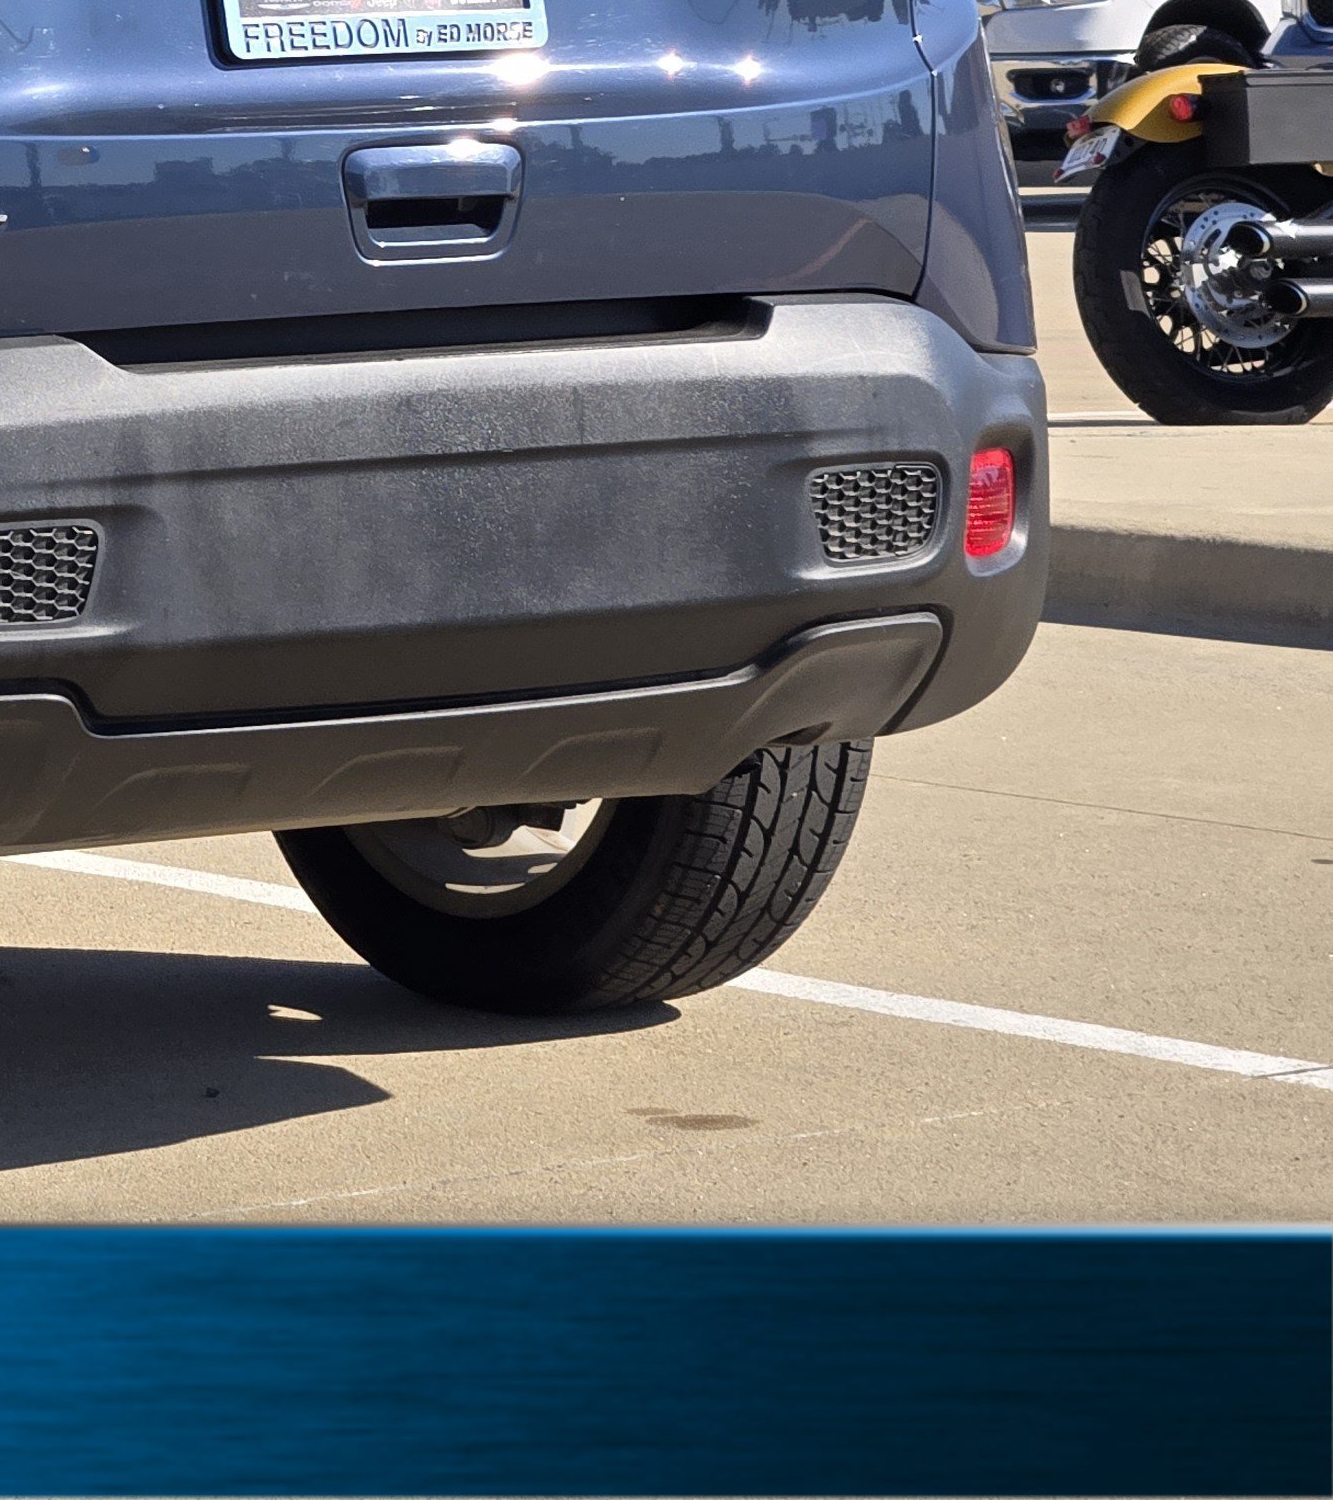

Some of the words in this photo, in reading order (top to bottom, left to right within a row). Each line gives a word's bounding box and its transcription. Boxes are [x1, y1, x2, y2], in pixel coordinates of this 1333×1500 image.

[241, 18, 410, 52] FREEDOM
[437, 24, 461, 42] ED
[466, 20, 533, 41] MORSE
